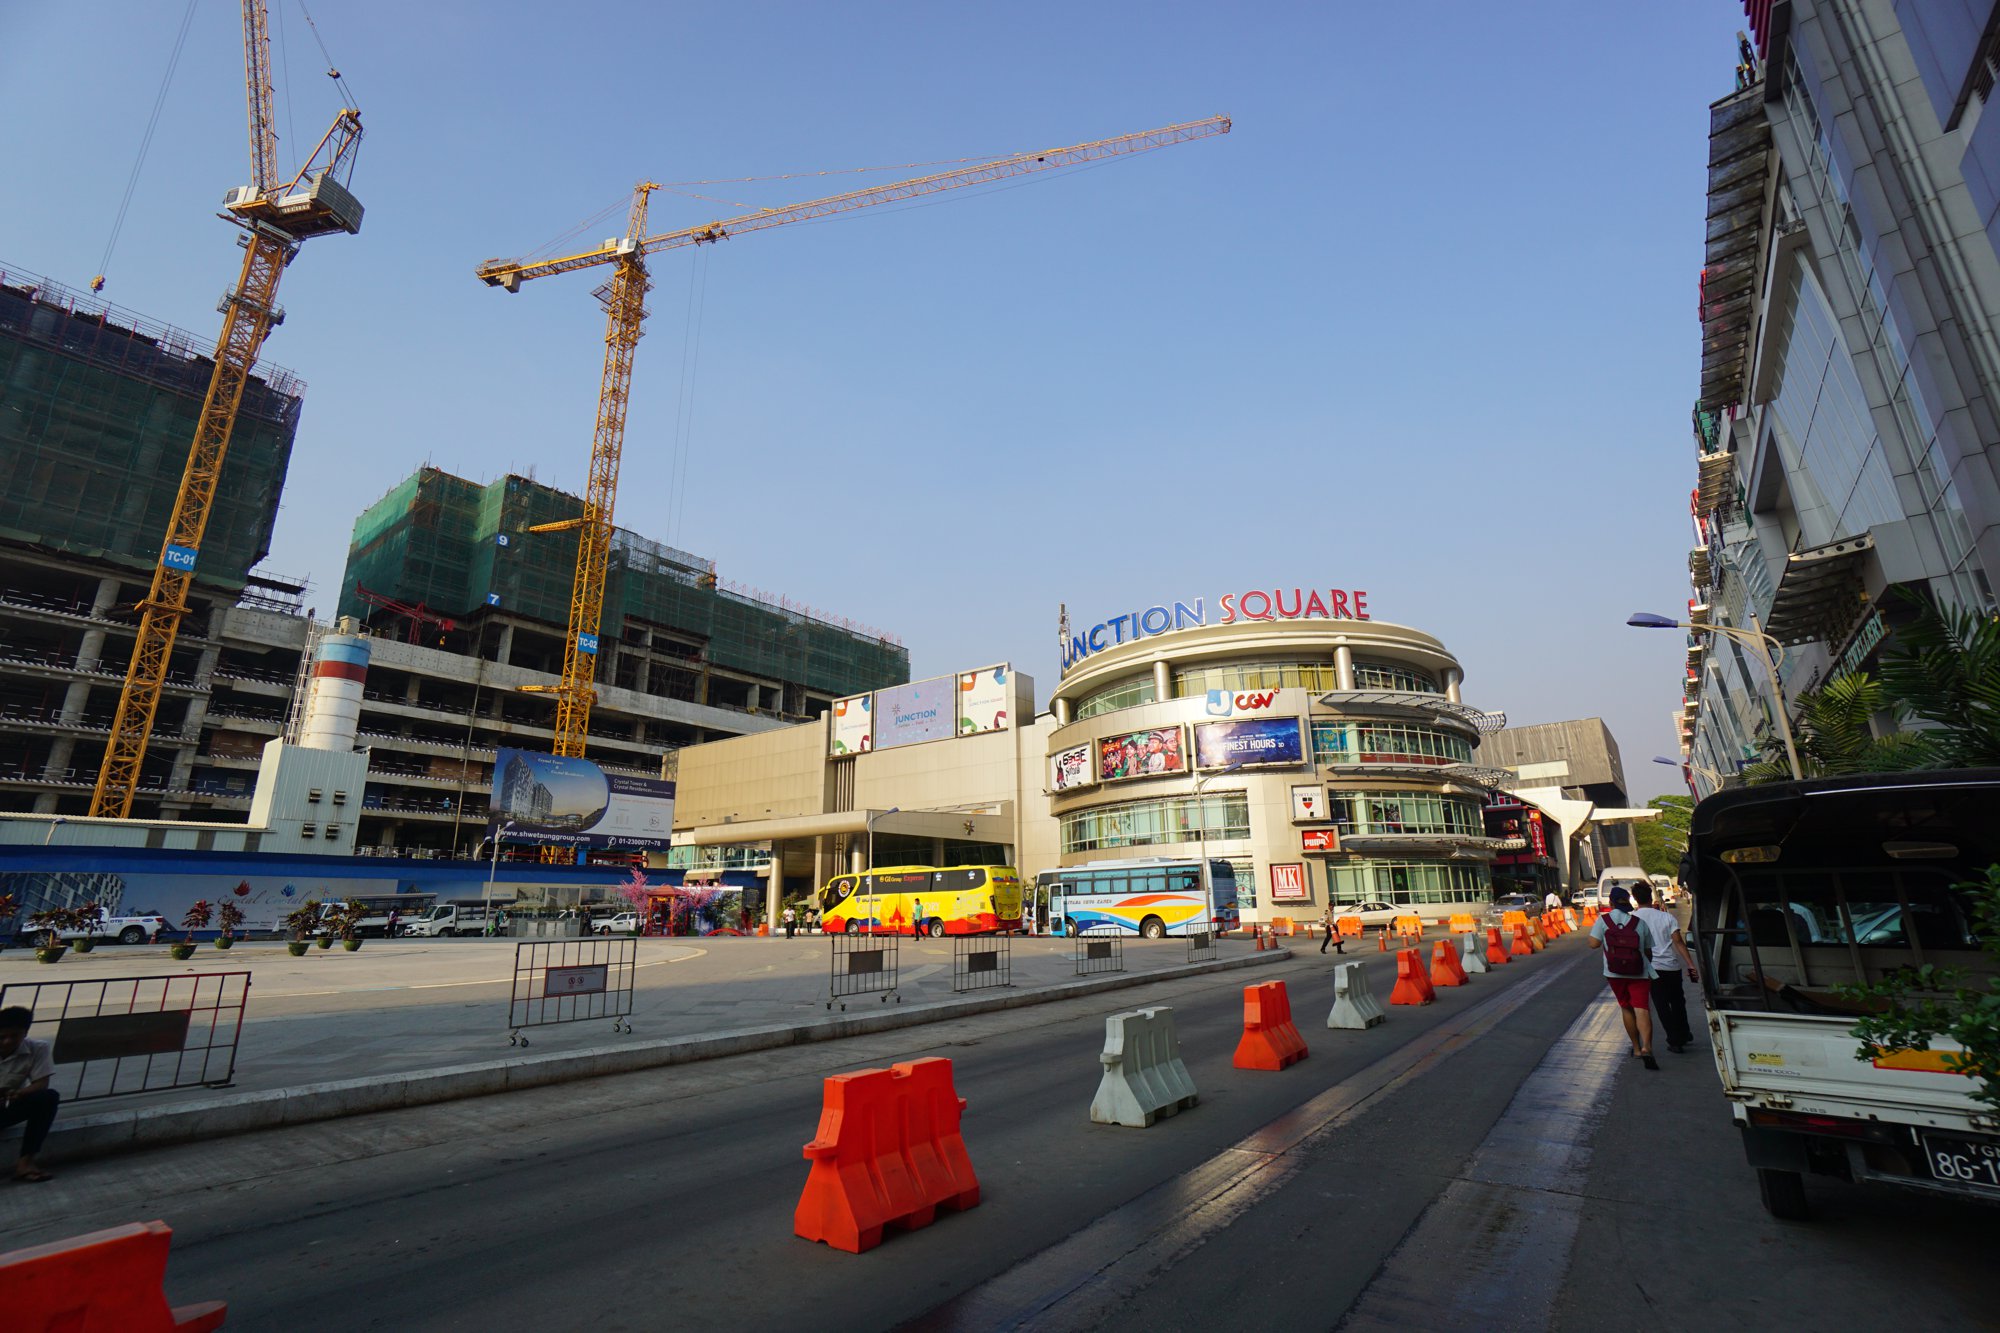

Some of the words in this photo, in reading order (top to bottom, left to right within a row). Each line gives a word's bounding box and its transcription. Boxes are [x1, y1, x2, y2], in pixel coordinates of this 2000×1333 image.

[499, 535, 508, 546] 9
[168, 550, 195, 566] TC-01
[490, 593, 500, 604] 7
[1219, 588, 1370, 624] SQUARE
[579, 637, 598, 649] TC-02
[1208, 690, 1230, 714] J
[1235, 687, 1275, 710] CGV
[895, 709, 937, 725] JUNCTION
[1223, 741, 1248, 751] FINEST
[1250, 739, 1276, 749] HOURS
[629, 785, 653, 793] Residences
[500, 831, 591, 842] www.shwetaunggroup.com
[1304, 838, 1327, 847] PUMA
[1276, 867, 1298, 889] MK
[1937, 1152, 2000, 1184] 8G-1
